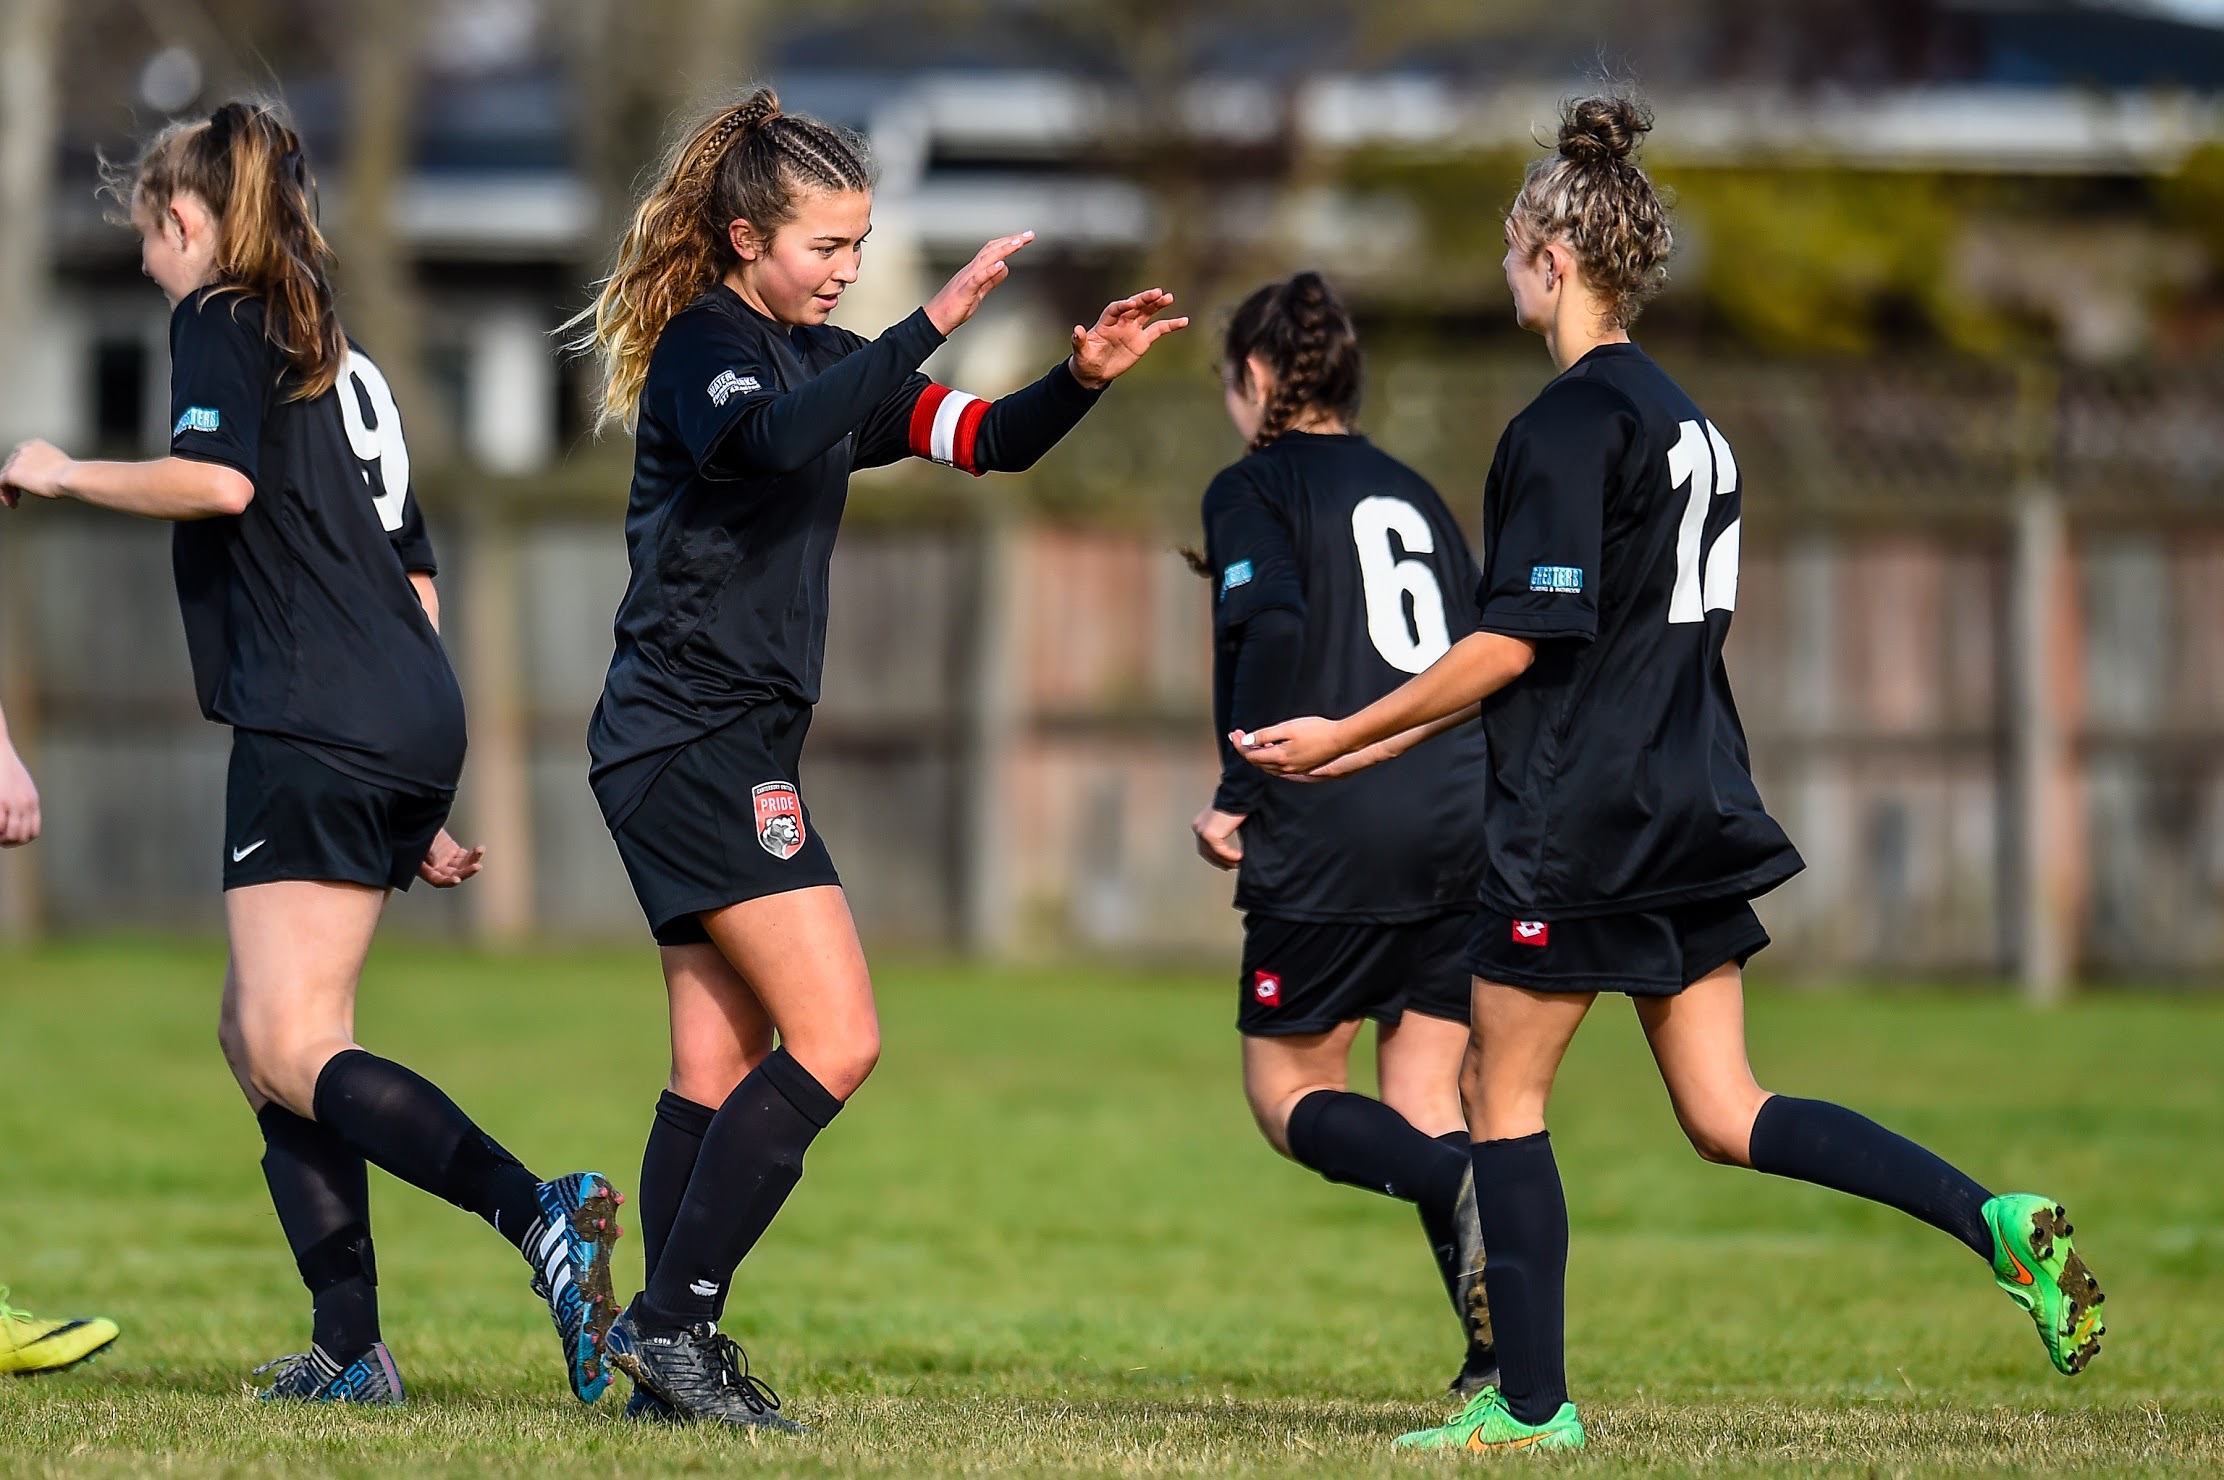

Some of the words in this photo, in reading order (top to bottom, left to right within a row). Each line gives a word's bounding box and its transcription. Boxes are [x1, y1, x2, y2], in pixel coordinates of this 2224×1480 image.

[335, 350, 410, 532] 9
[1667, 418, 1741, 624] 12
[1351, 495, 1452, 675] 6
[760, 796, 795, 812] PRIDE
[653, 1337, 671, 1346] COPA
